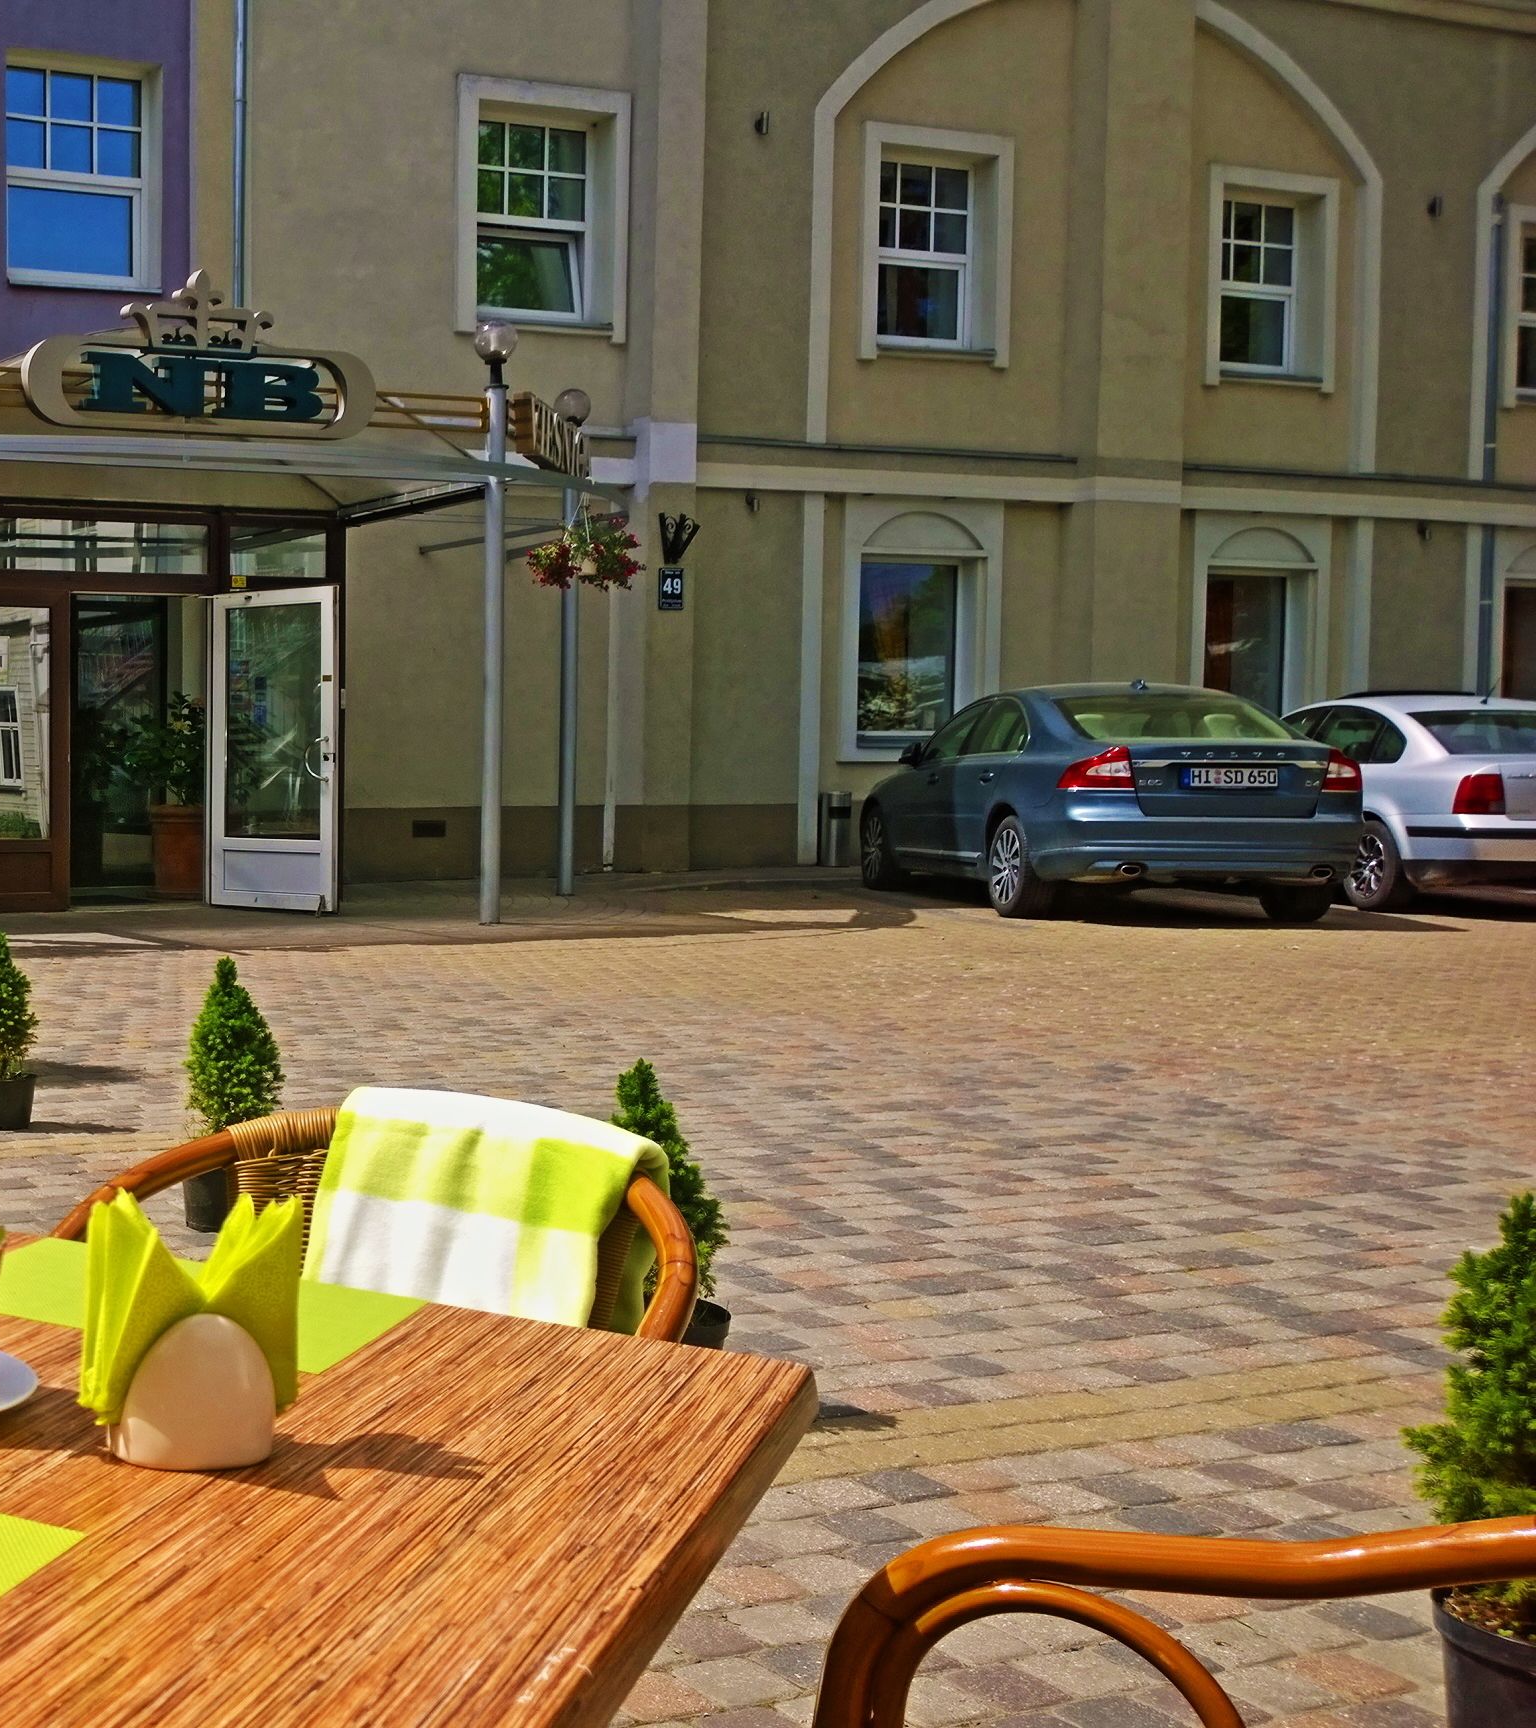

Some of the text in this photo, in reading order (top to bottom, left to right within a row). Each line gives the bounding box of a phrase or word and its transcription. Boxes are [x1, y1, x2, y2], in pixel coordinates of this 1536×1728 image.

[80, 350, 326, 420] NB
[663, 577, 682, 594] 49
[1192, 769, 1277, 785] HI SD 650
